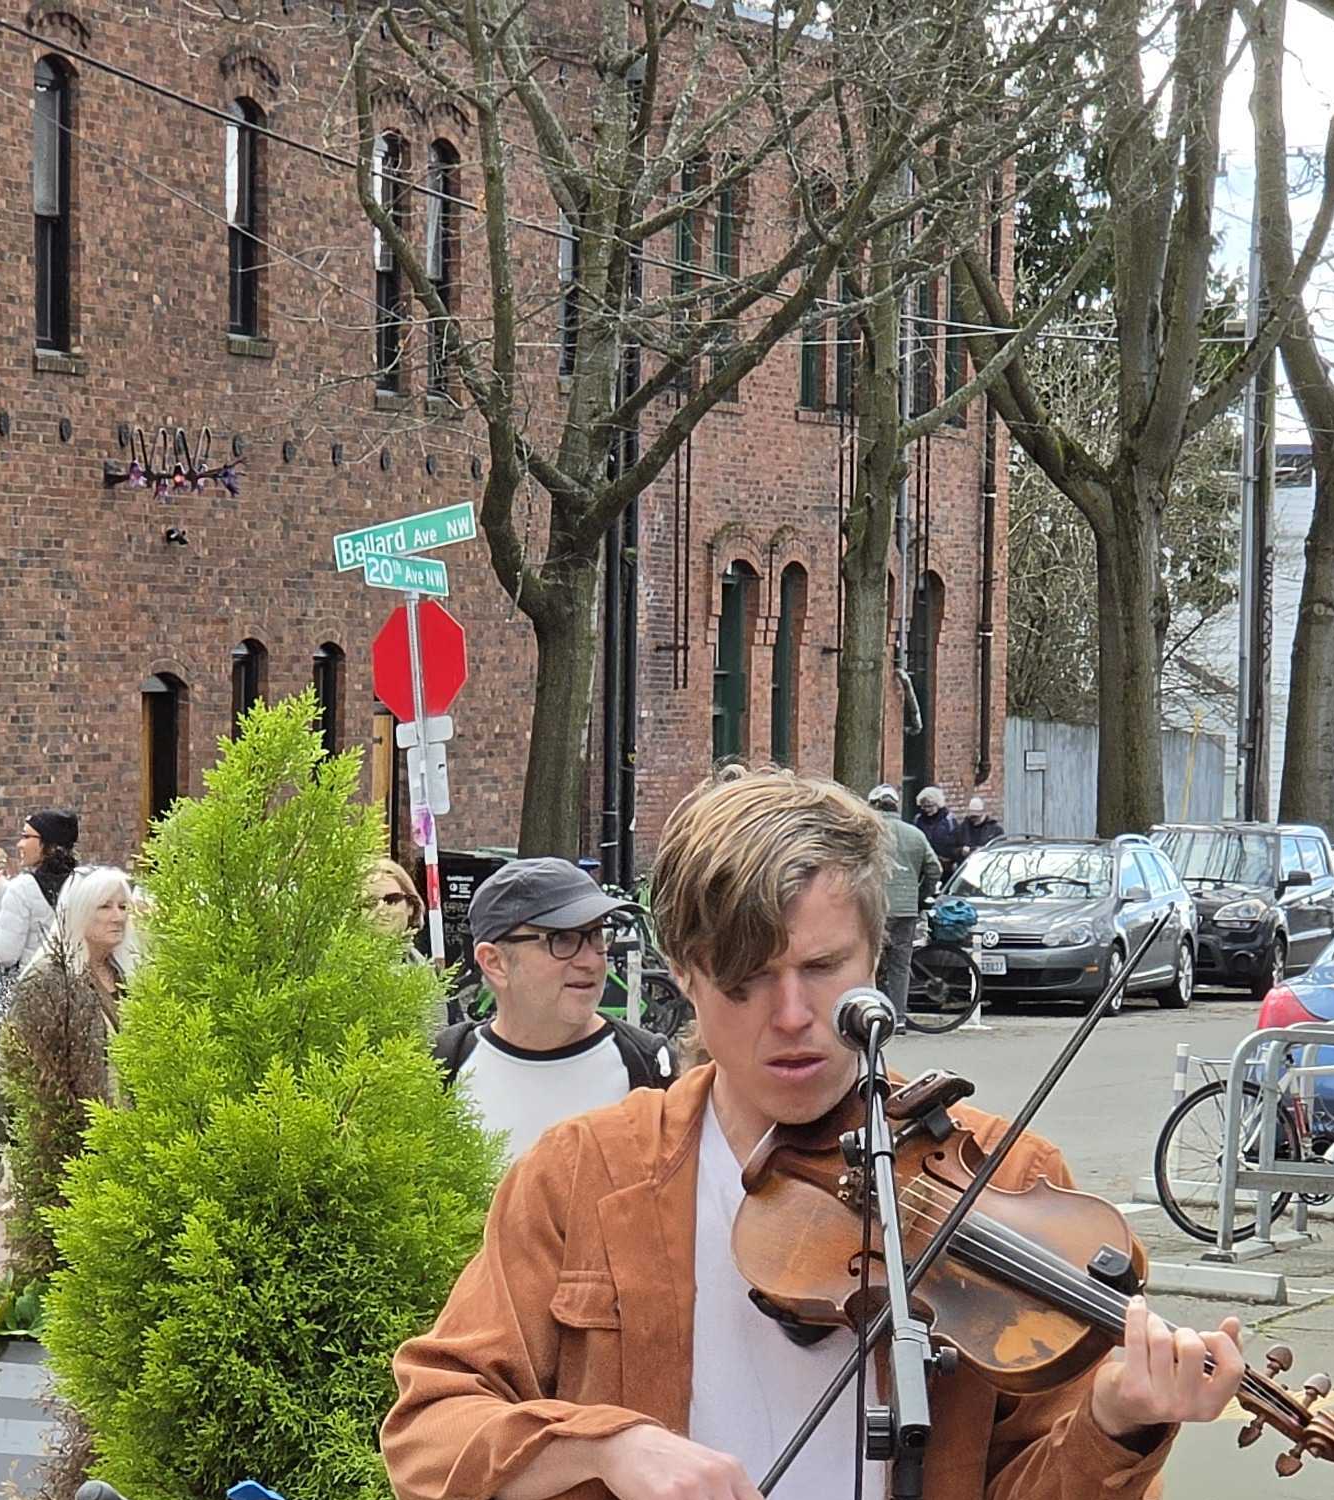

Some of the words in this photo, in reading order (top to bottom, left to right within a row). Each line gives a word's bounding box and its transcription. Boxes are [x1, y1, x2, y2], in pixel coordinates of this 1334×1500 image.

[339, 526, 406, 566] Ballard
[413, 529, 438, 548] Ave
[445, 517, 470, 538] NW
[368, 557, 402, 584] 20th
[404, 566, 424, 584] Ave
[426, 568, 444, 588] NW
